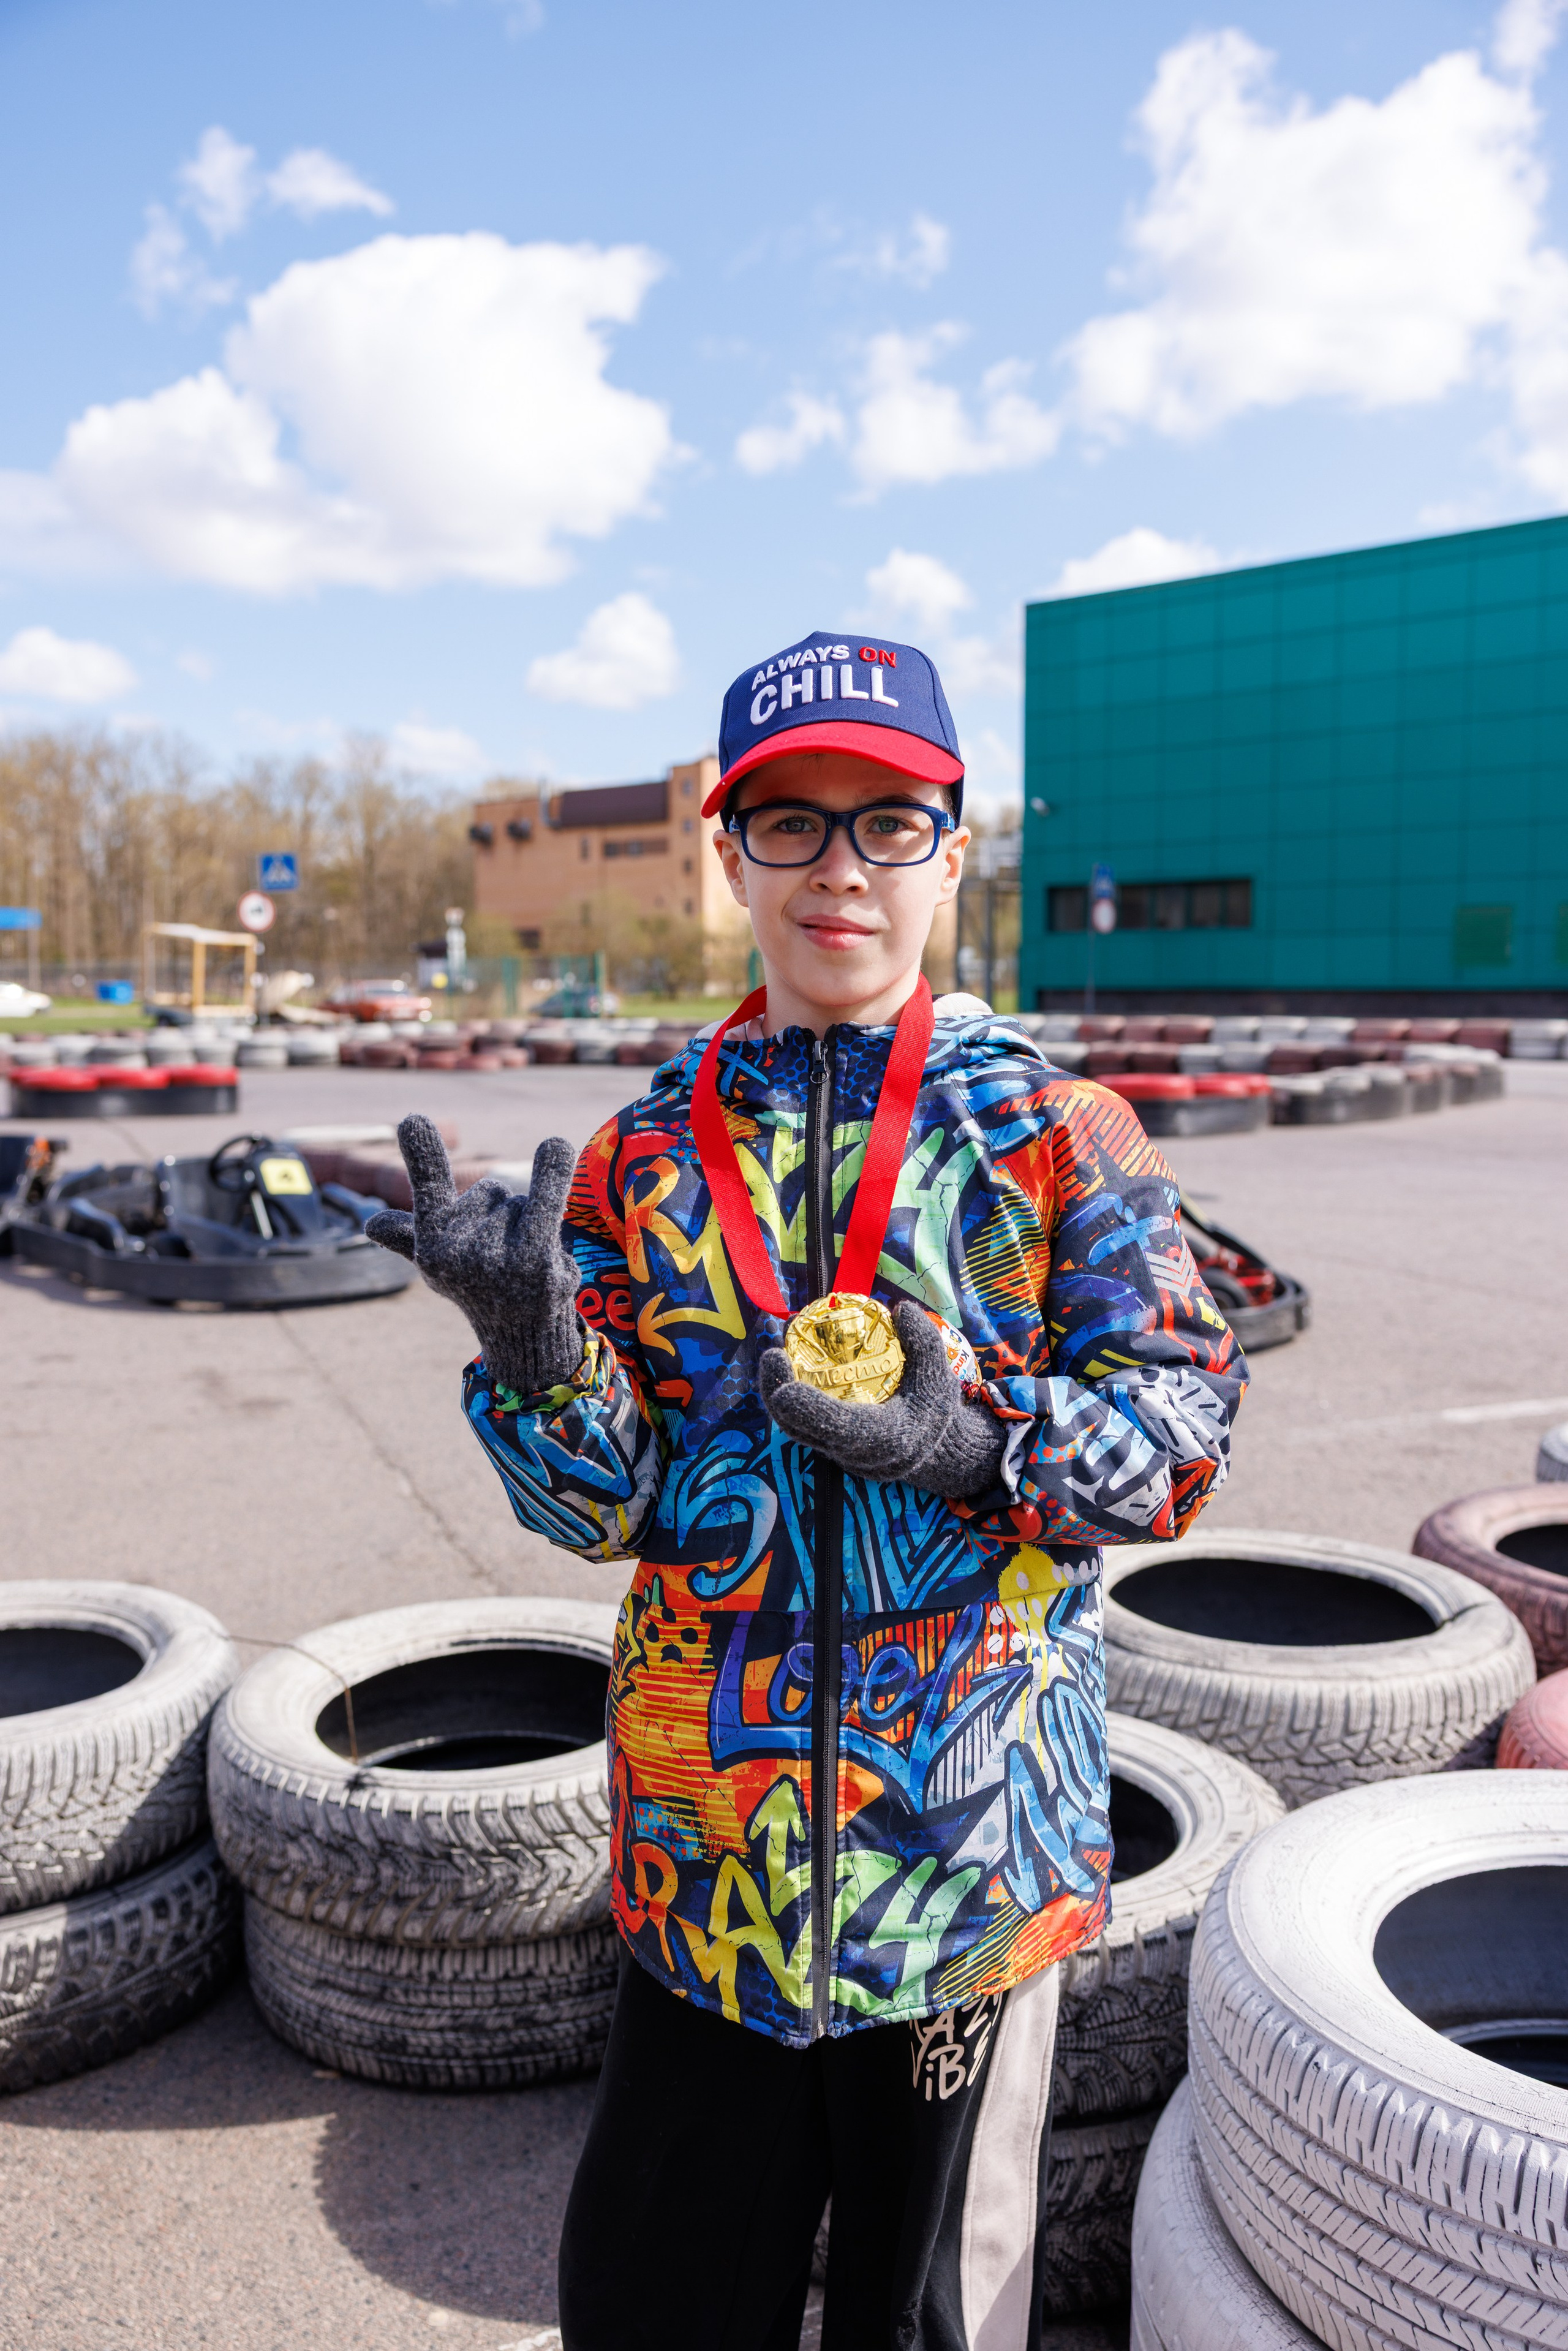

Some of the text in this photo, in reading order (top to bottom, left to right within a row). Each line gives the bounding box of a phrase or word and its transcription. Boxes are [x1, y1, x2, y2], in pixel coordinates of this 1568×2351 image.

[751, 644, 897, 691] ALWAYS ON
[750, 664, 899, 726] CHILL
